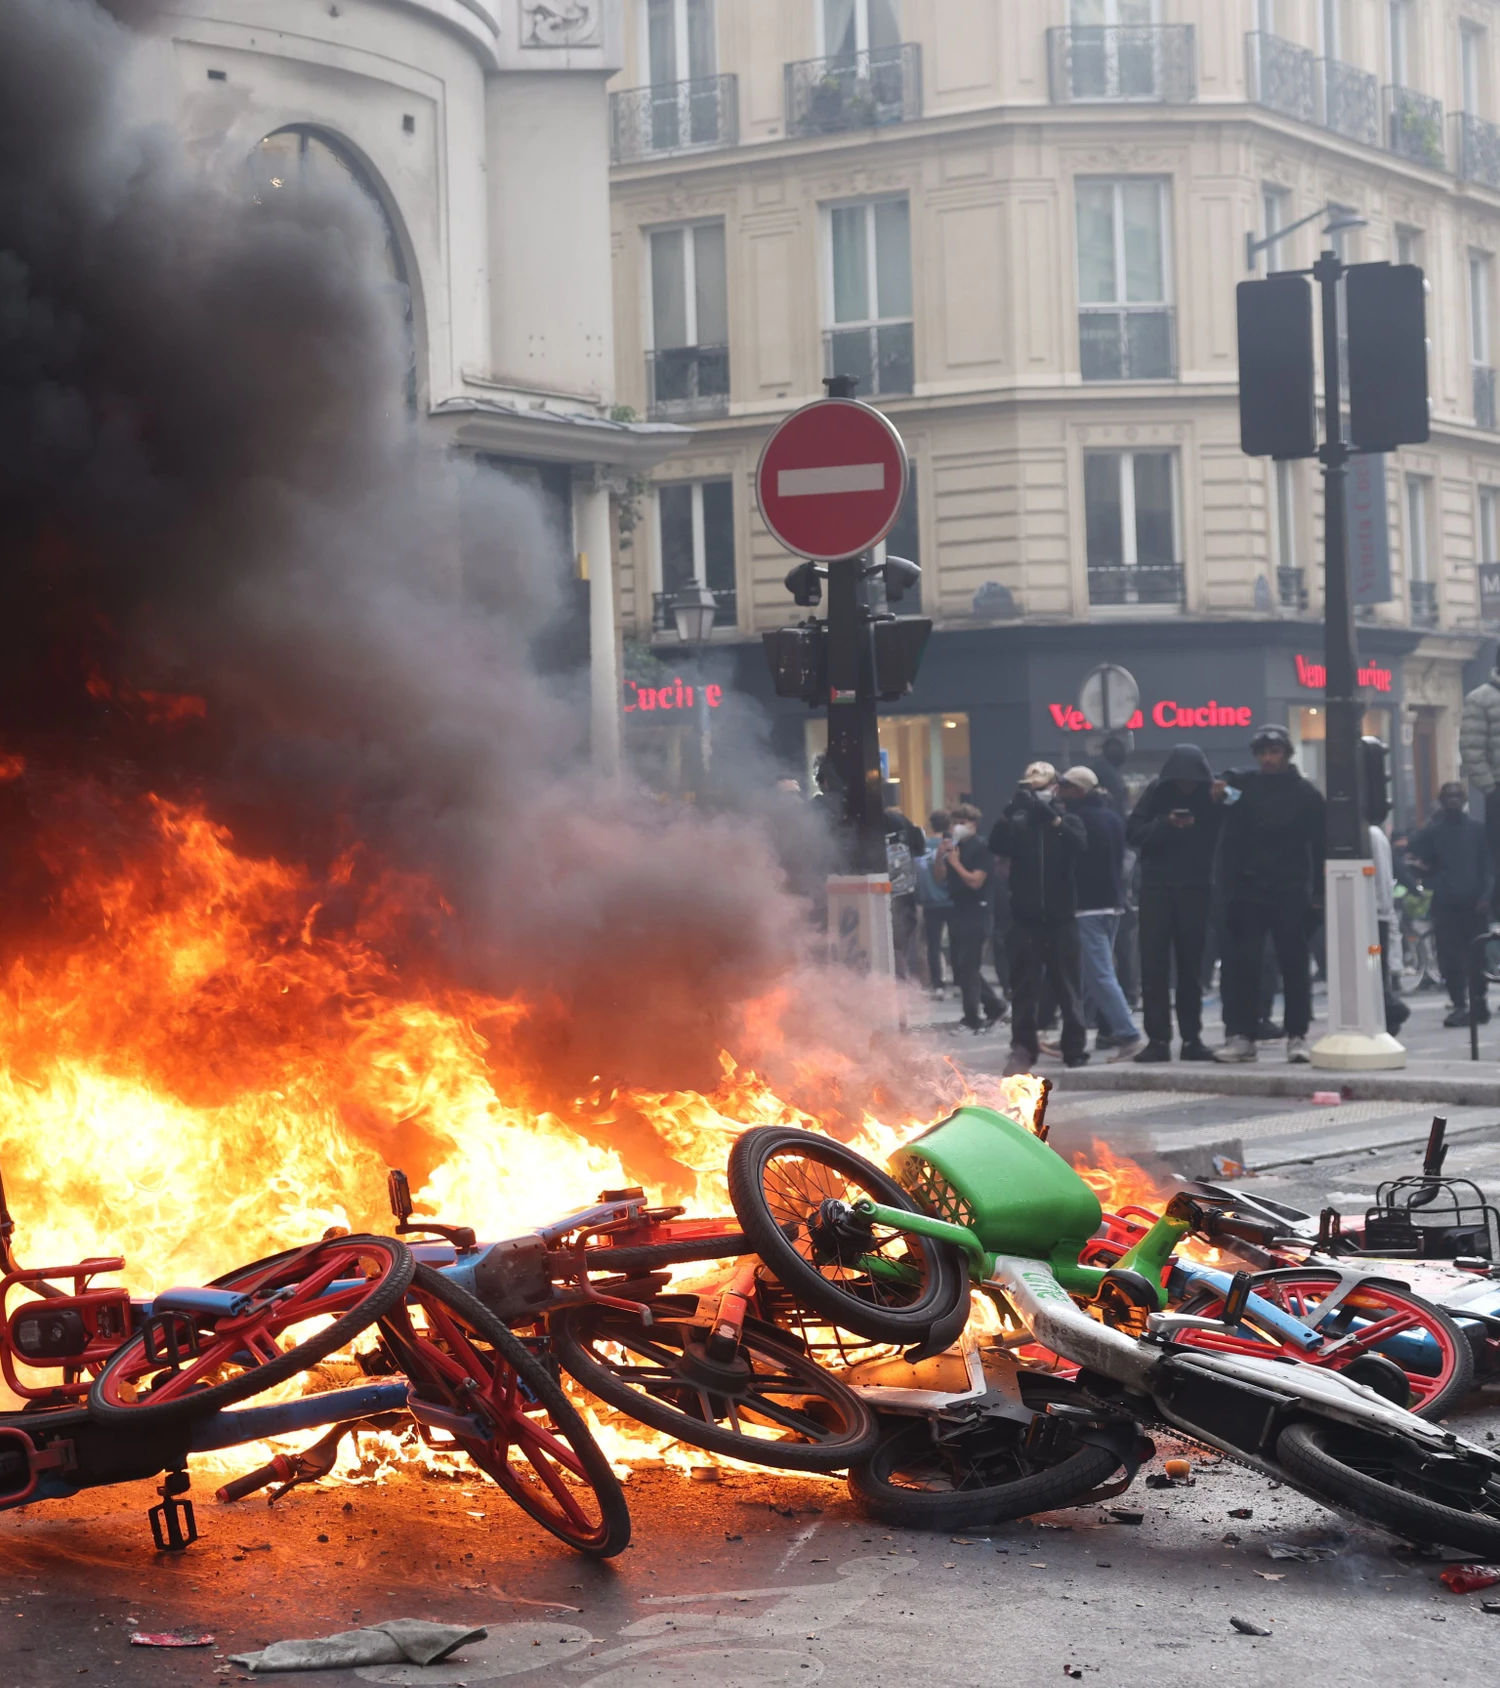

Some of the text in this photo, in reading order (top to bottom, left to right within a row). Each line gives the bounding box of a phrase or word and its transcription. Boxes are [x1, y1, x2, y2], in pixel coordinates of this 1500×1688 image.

[1294, 654, 1392, 692] Ven ucine
[1048, 700, 1252, 731] Vea Cucine
